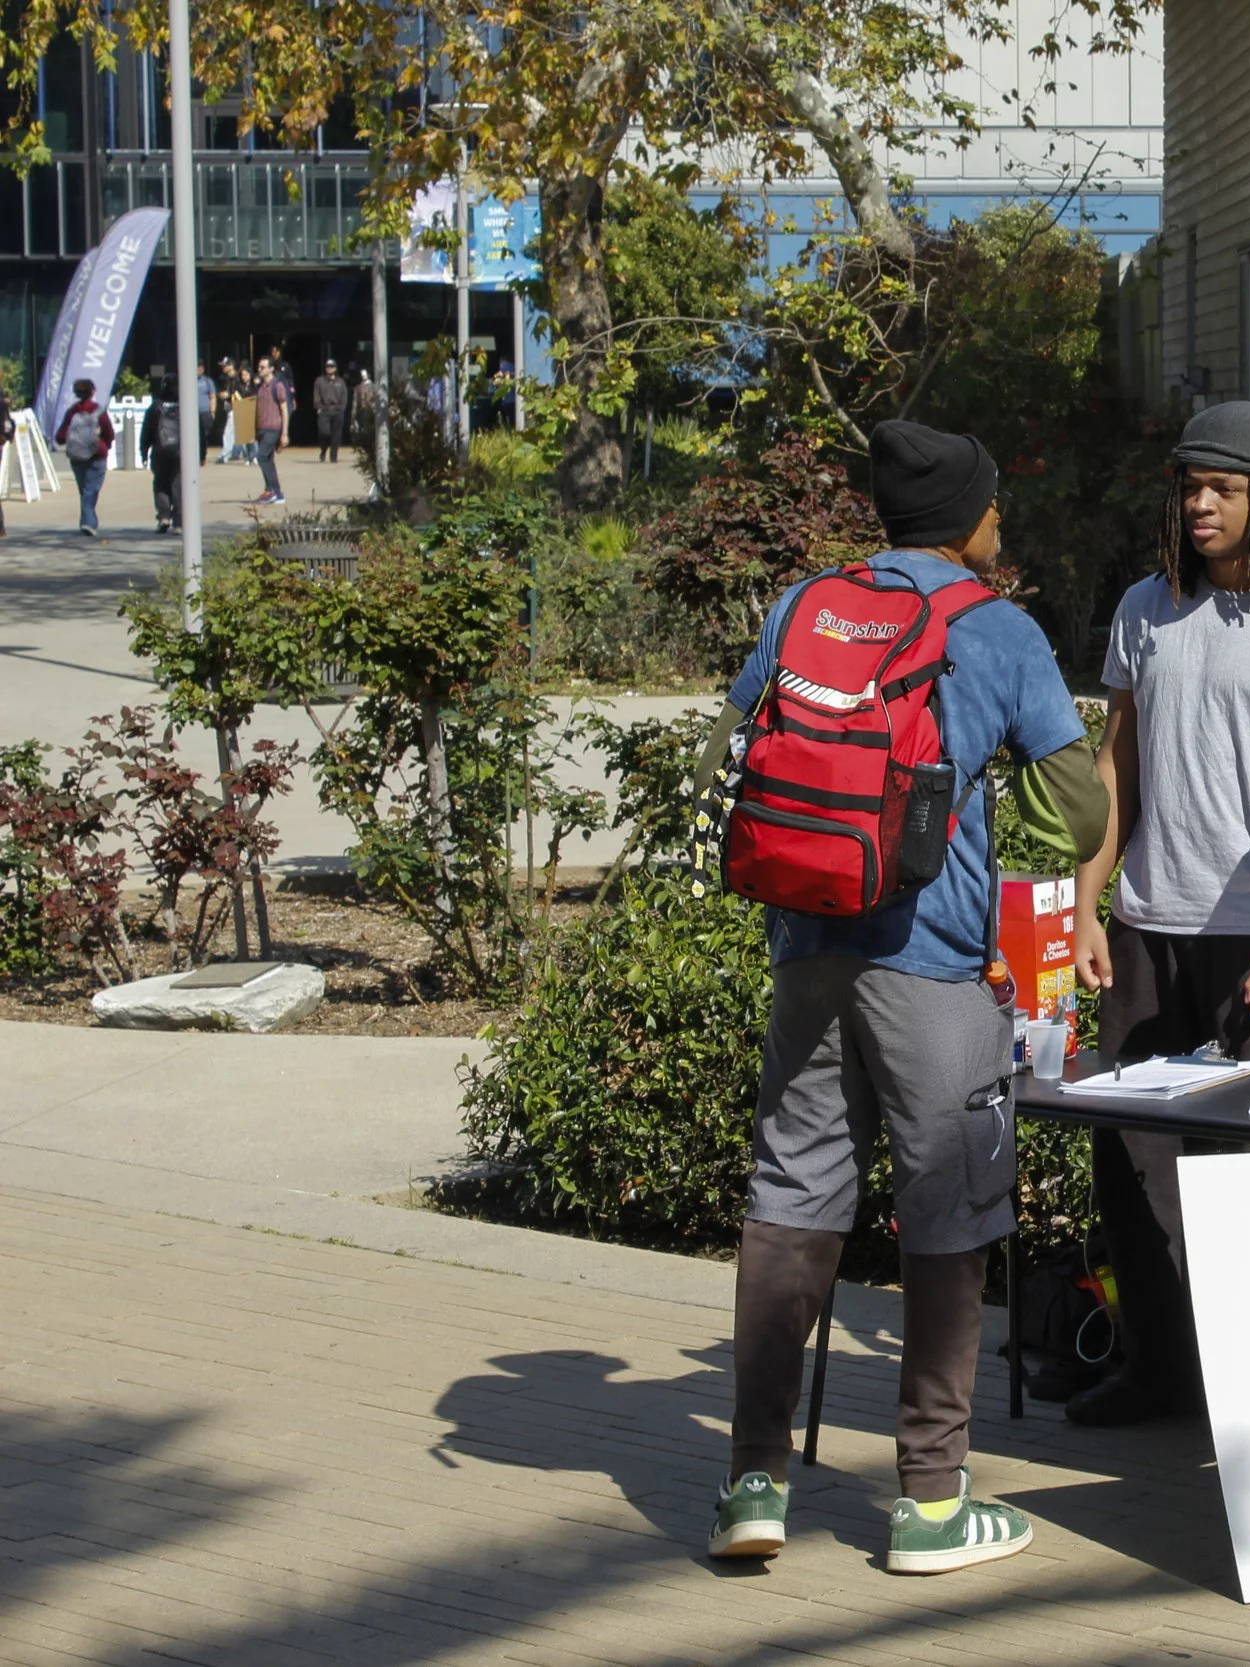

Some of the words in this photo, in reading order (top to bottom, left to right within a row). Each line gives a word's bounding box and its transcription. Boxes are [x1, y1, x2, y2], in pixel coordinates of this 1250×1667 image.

[83, 235, 141, 369] WELCOME
[815, 608, 905, 640] Sunshin
[1046, 940, 1067, 952] Doritos
[1048, 948, 1071, 961] Cheetos
